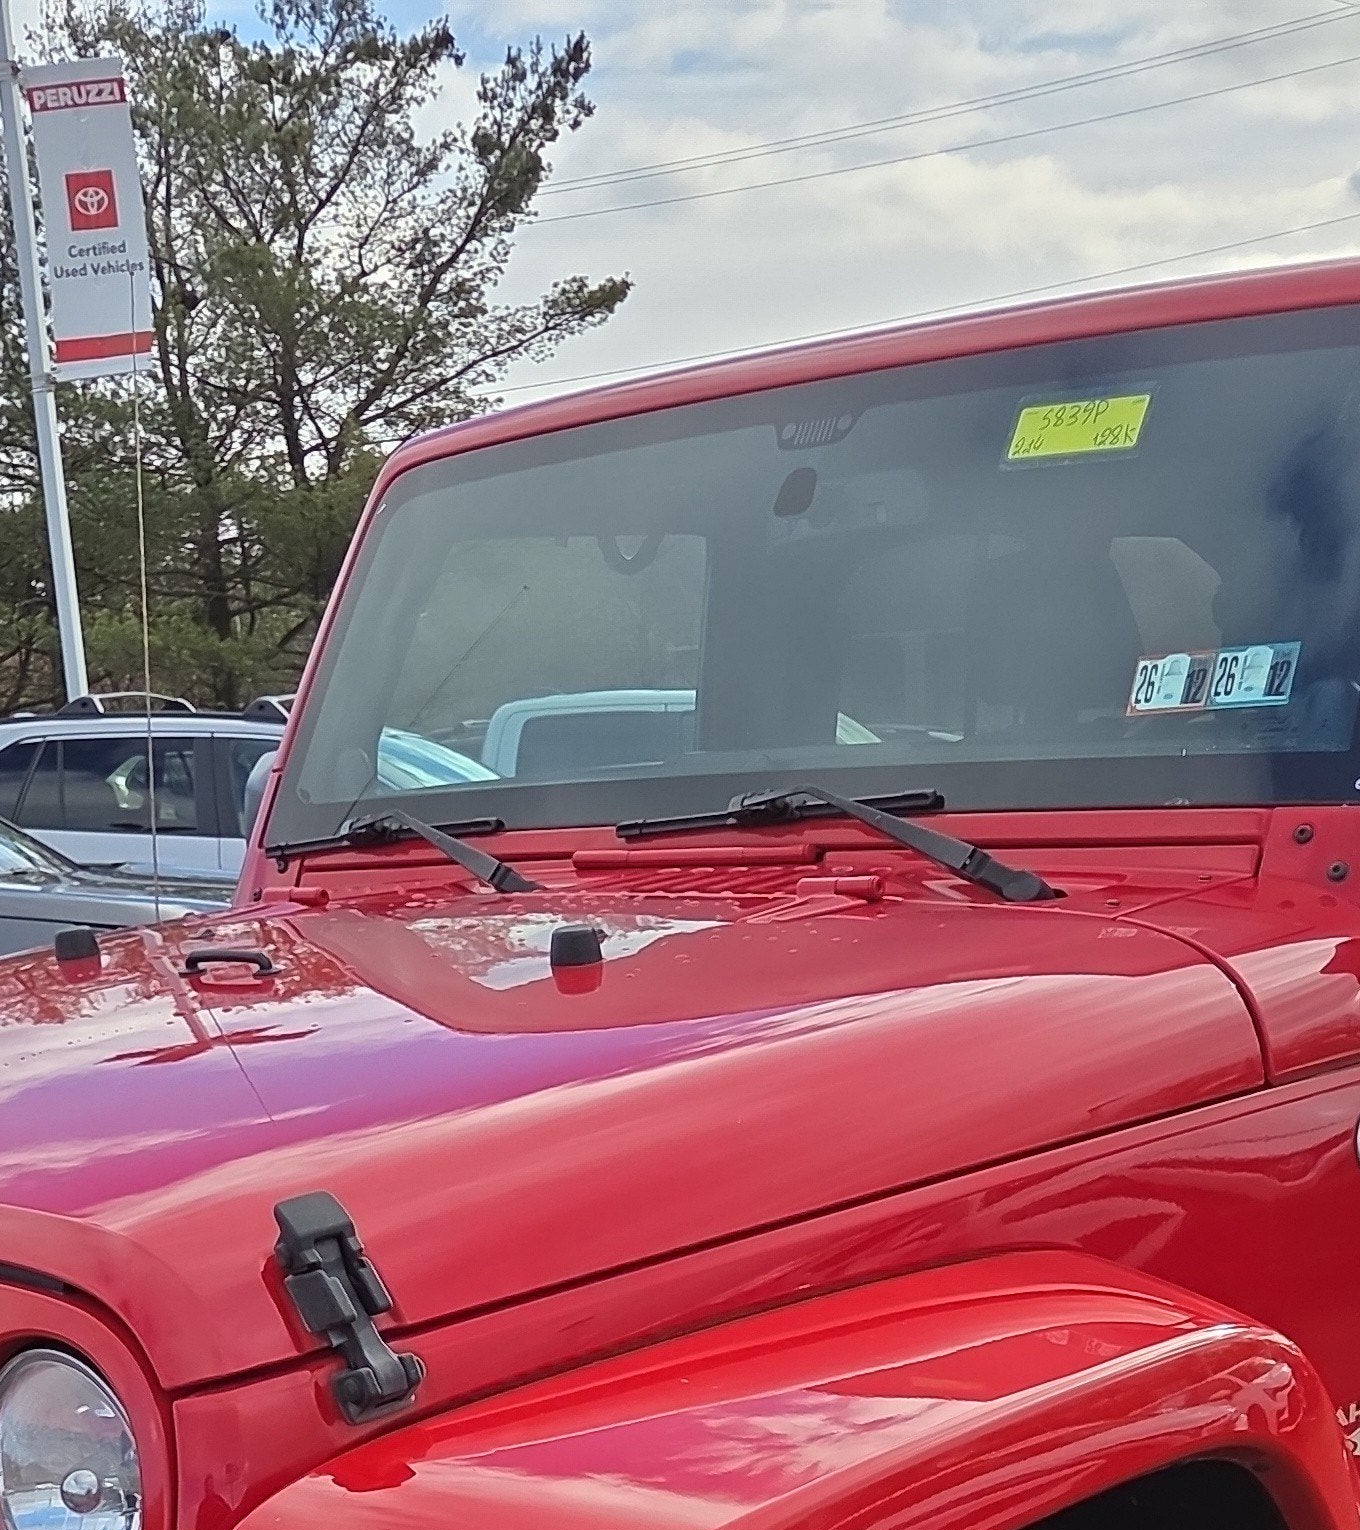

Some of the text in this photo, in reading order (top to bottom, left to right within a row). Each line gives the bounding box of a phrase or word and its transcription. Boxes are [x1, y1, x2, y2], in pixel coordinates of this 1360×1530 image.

[33, 81, 122, 111] PERUZZI
[68, 239, 127, 258] Certified
[54, 259, 145, 279] Used Vehicles
[1134, 663, 1159, 705] 26
[1180, 668, 1208, 706] 12
[1213, 655, 1239, 698] 26
[1262, 659, 1292, 697] 12
